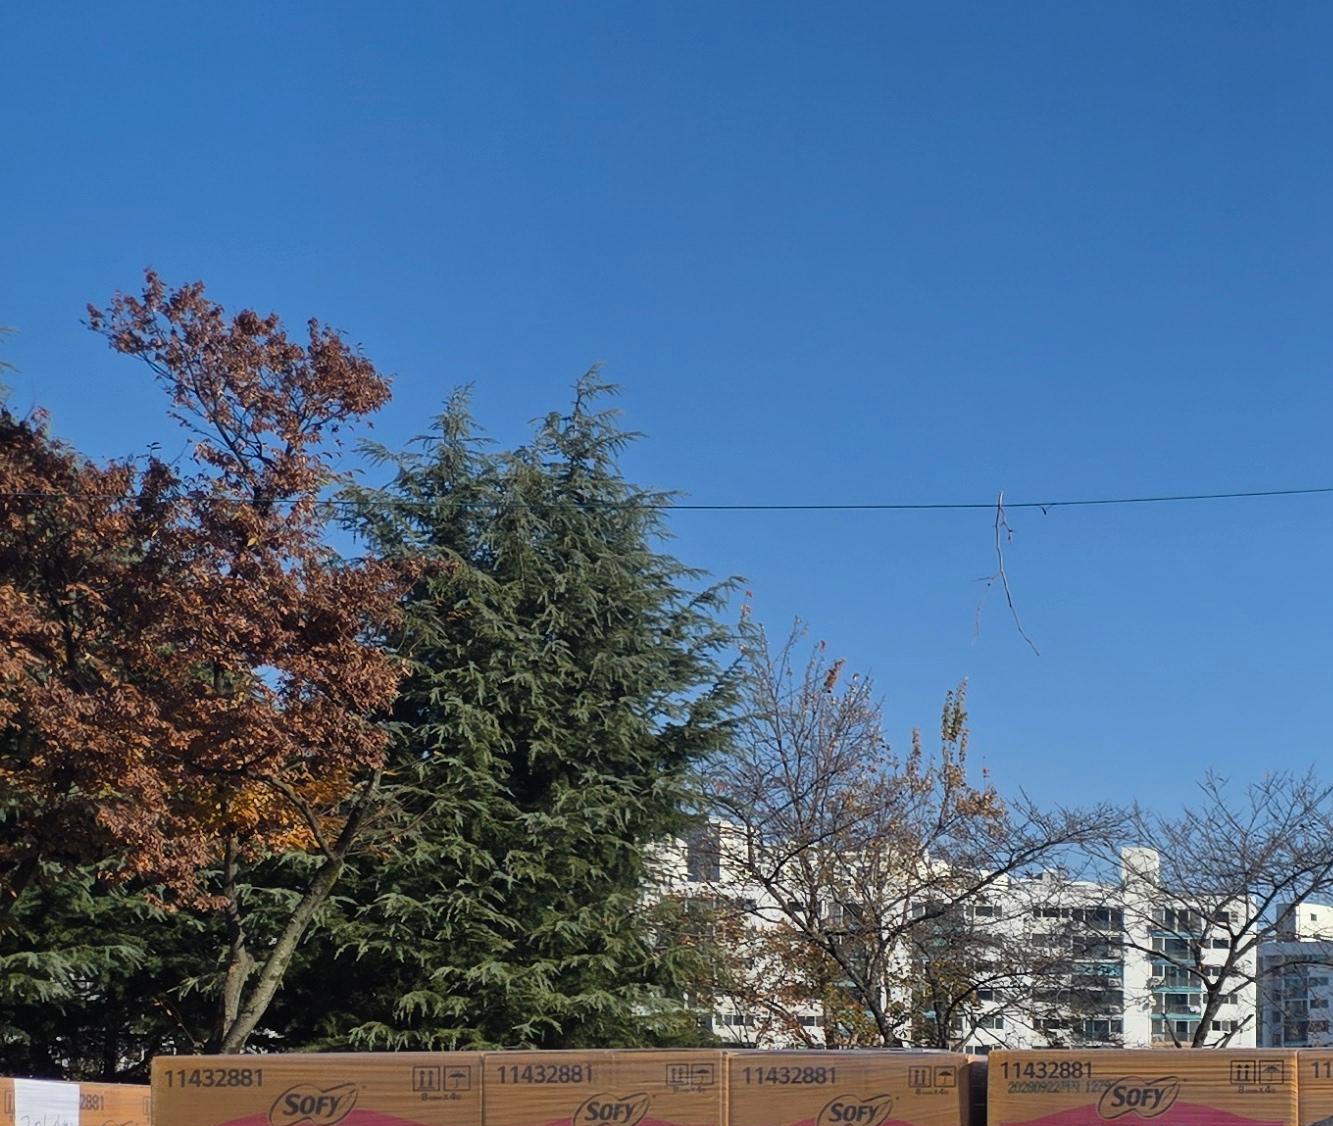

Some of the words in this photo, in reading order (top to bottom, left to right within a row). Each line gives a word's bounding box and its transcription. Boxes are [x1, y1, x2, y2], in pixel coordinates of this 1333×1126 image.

[164, 1069, 263, 1087] 11432881
[497, 1066, 593, 1085] 11432881
[742, 1066, 837, 1085] 11432881
[1000, 1061, 1093, 1080] 11432881
[80, 1094, 104, 1111] 2881
[282, 1096, 344, 1119] SOFY
[1111, 1086, 1165, 1110] SOFY
[584, 1101, 636, 1124] SOFY
[828, 1102, 880, 1124] SOFY
